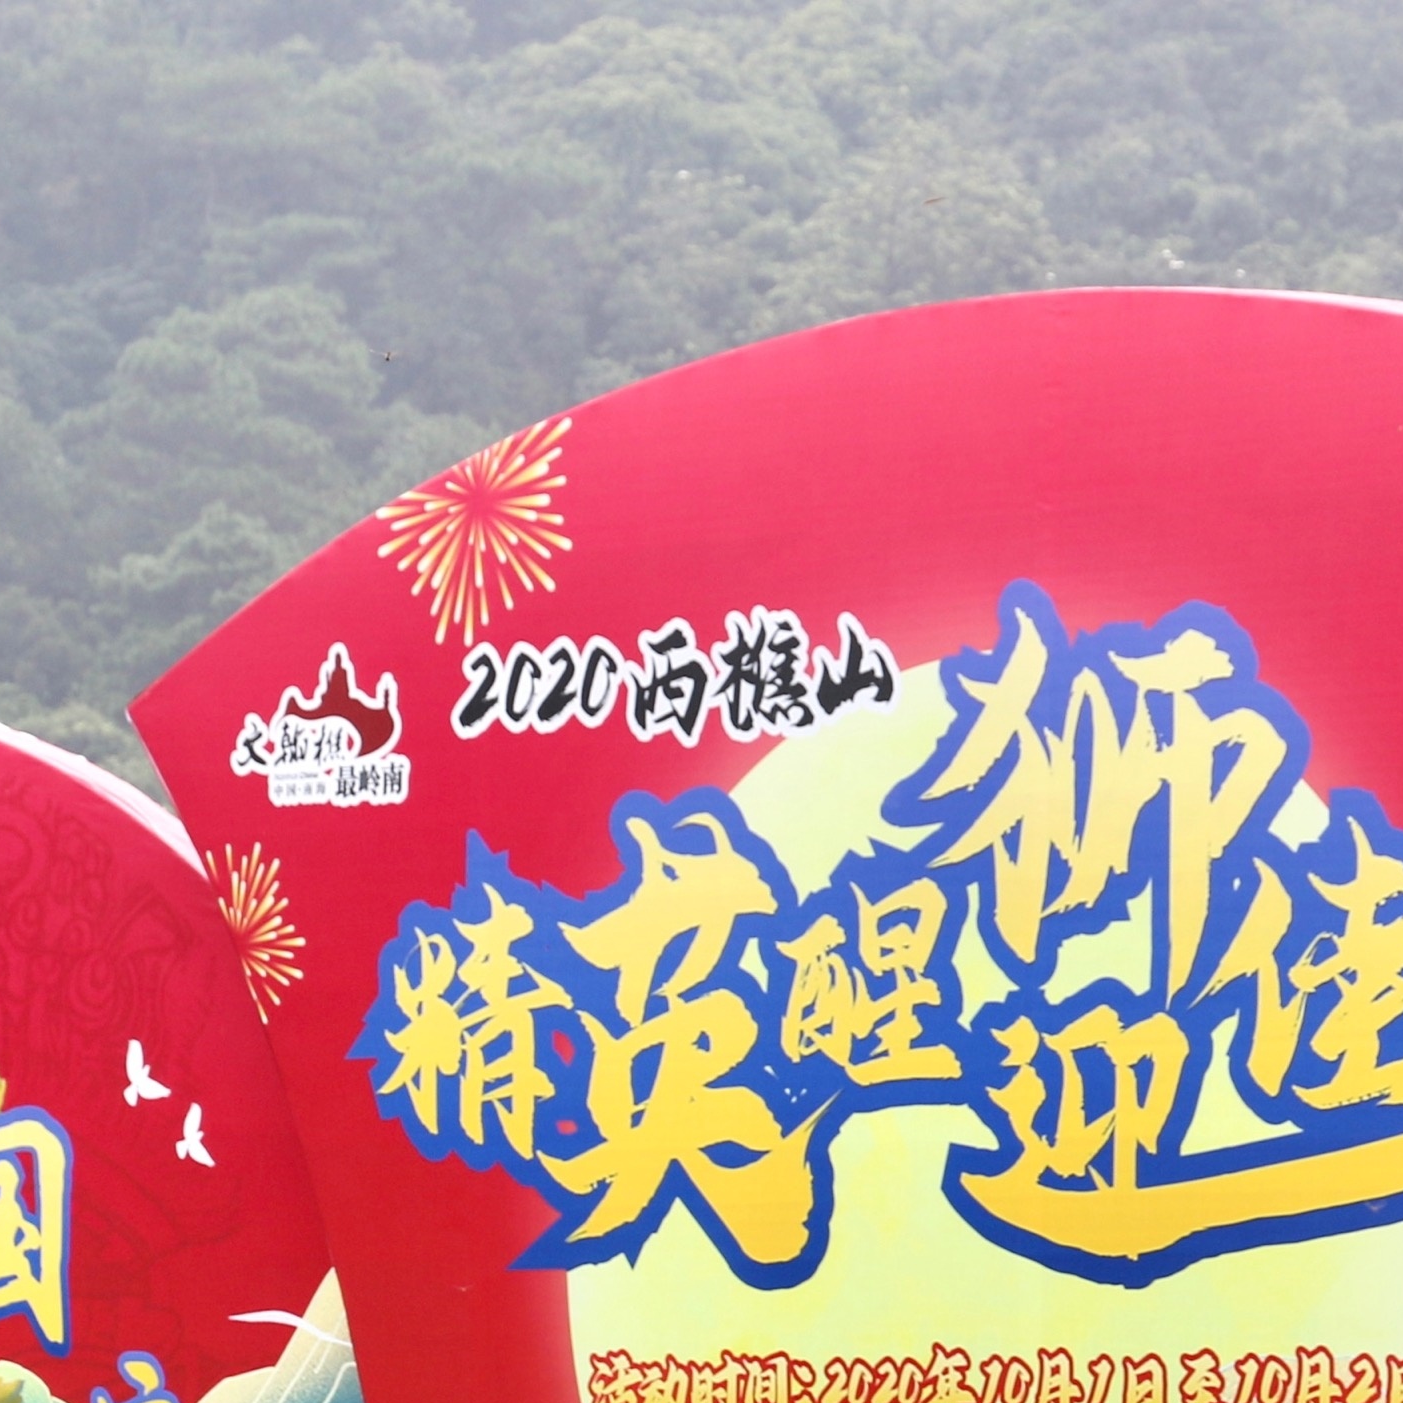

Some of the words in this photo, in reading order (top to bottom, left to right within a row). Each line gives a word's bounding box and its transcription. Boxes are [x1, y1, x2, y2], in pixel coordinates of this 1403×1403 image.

[459, 615, 894, 737] 2020西樵山
[335, 762, 405, 799] 最岭南
